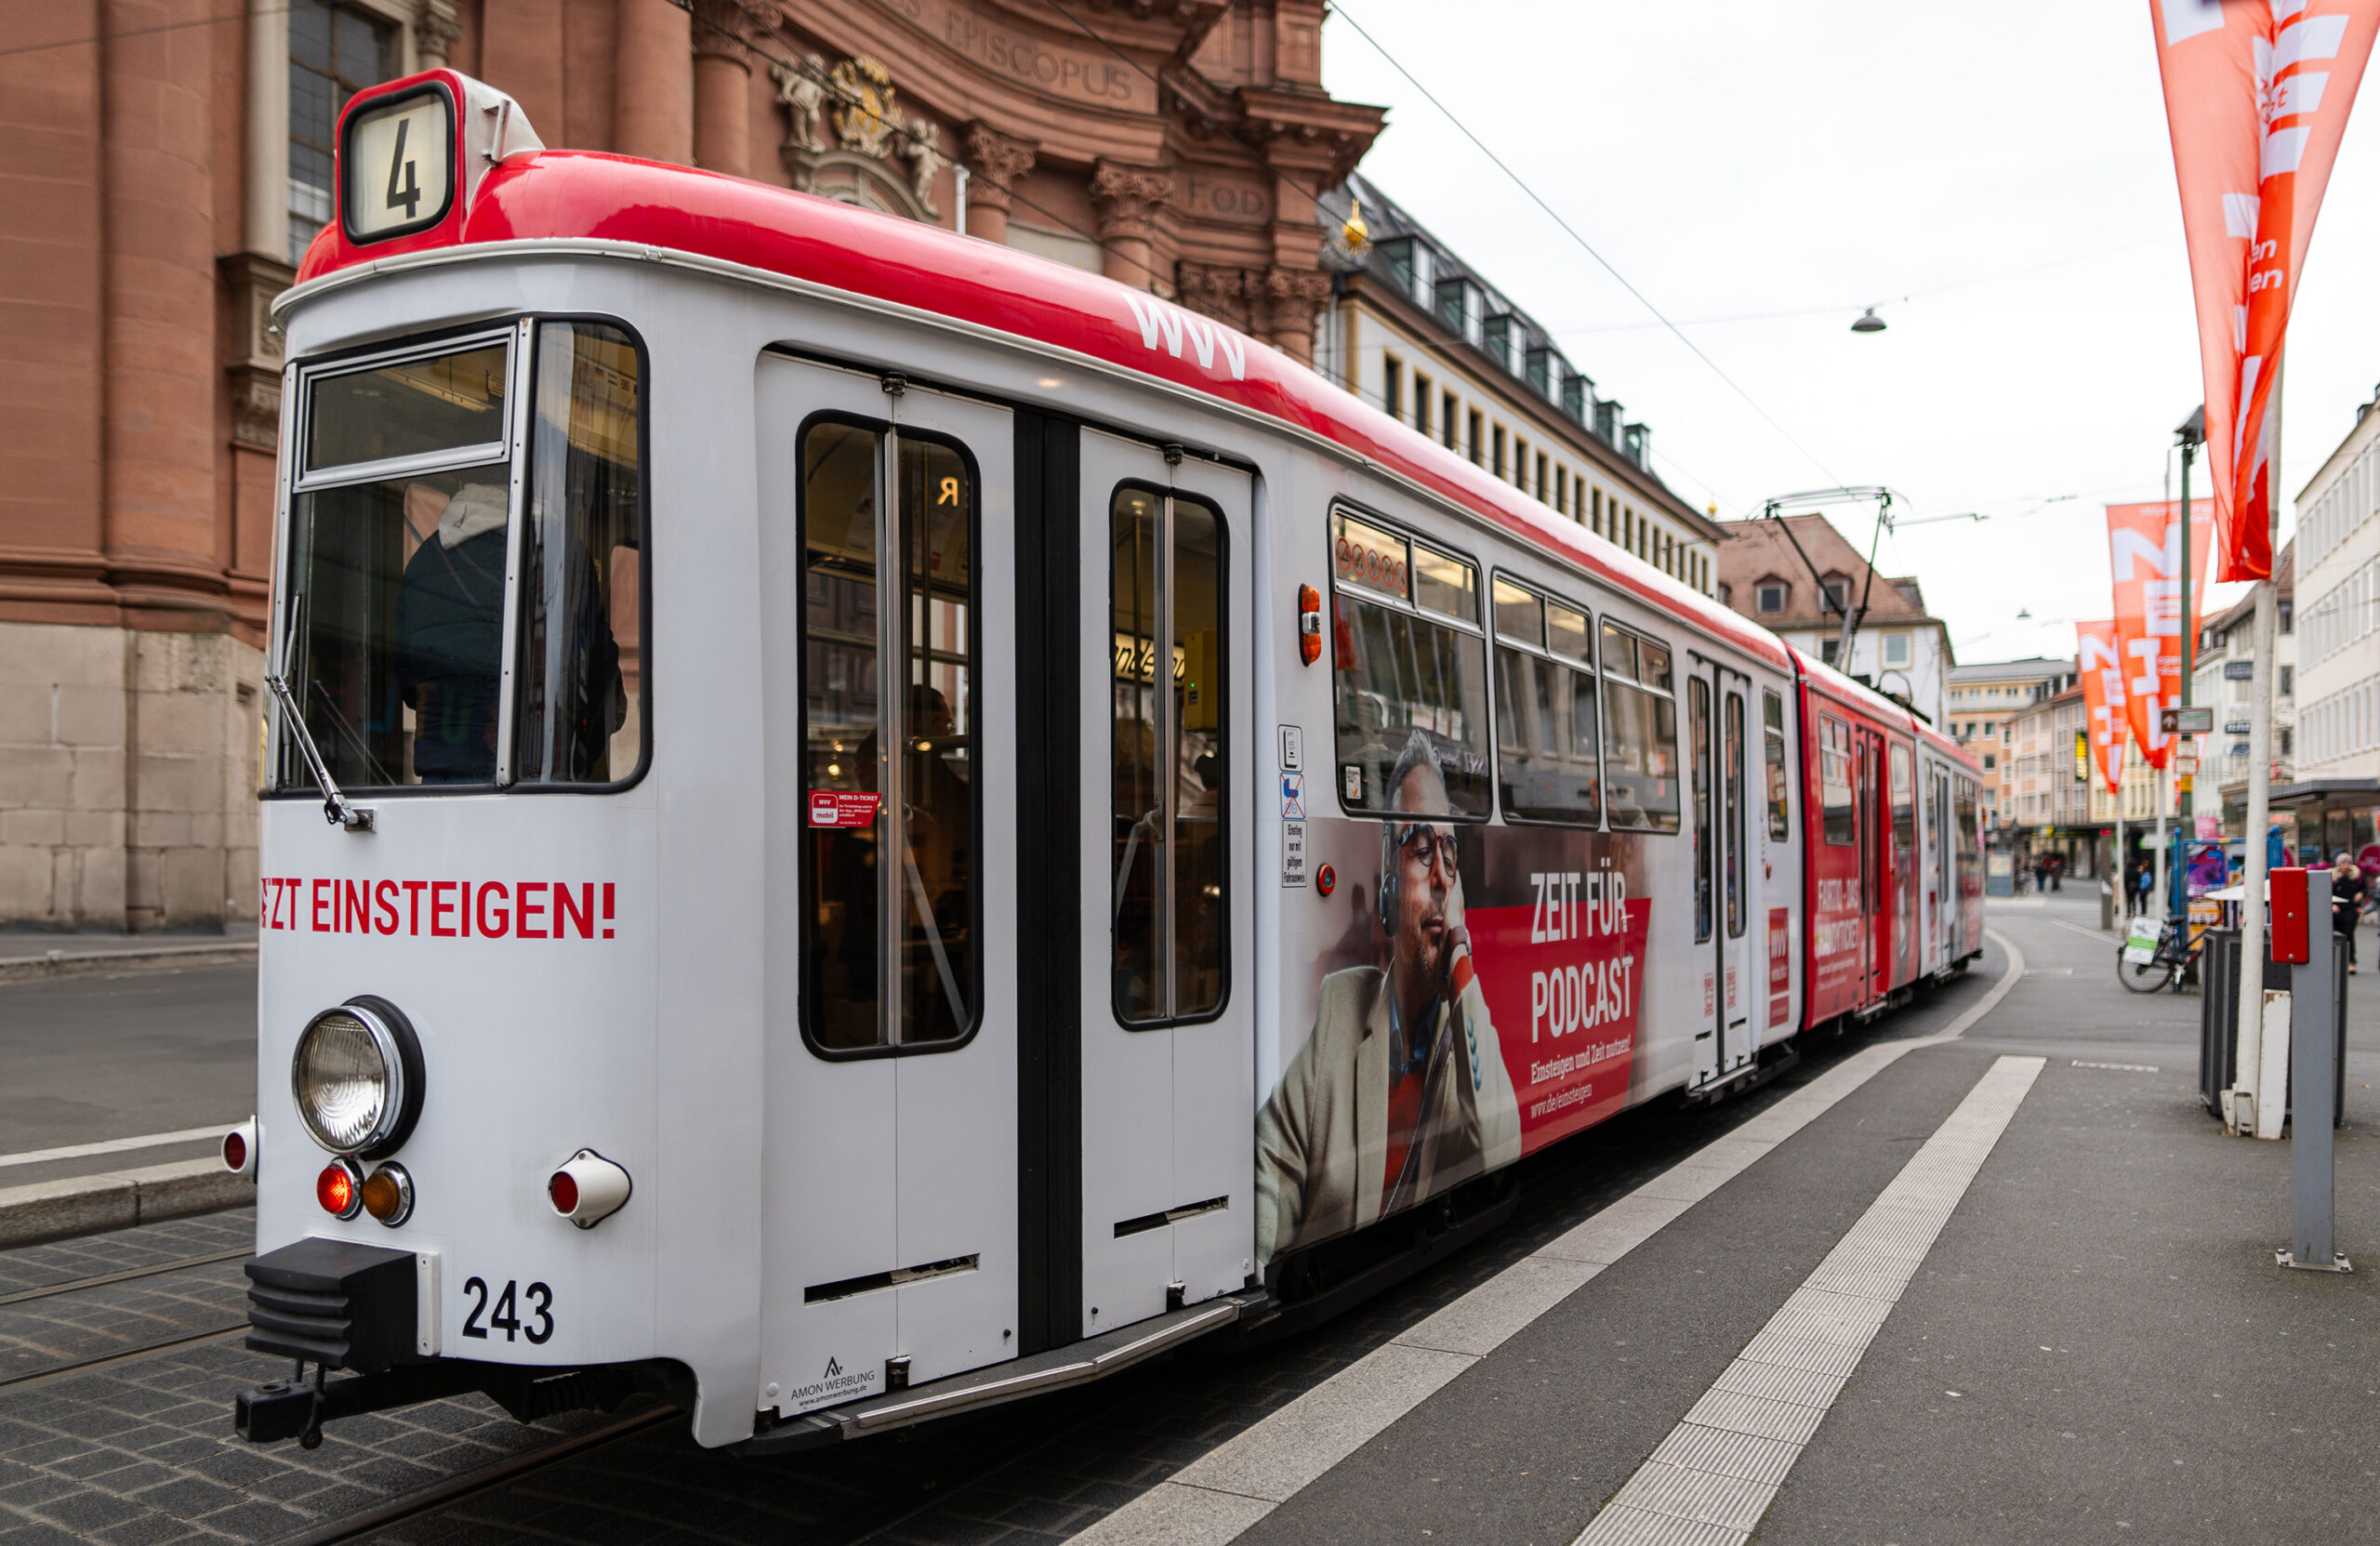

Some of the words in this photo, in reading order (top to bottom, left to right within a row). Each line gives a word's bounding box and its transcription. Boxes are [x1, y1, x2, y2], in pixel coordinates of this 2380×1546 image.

[945, 10, 1132, 101] EPISCOPUS
[386, 118, 421, 219] 4
[1120, 291, 1245, 382] WVV
[1288, 824, 1302, 839] Einstieg
[312, 879, 615, 939] EINSTEIGEN!
[1284, 871, 1305, 883] Fahrausweis
[1530, 872, 1580, 945] ZEIT
[1587, 857, 1628, 938] FÜR
[1532, 956, 1633, 1044] PODCAST
[1531, 1054, 1575, 1086] Einsteigen
[1575, 1044, 1591, 1069] und
[1591, 1041, 1606, 1064] Zeit
[1606, 1033, 1632, 1060] nutzen!
[461, 1275, 555, 1345] 243
[790, 1382, 824, 1401] AMON
[825, 1370, 875, 1392] WERBUNG
[799, 1384, 867, 1407] www.amonwerbung.de
